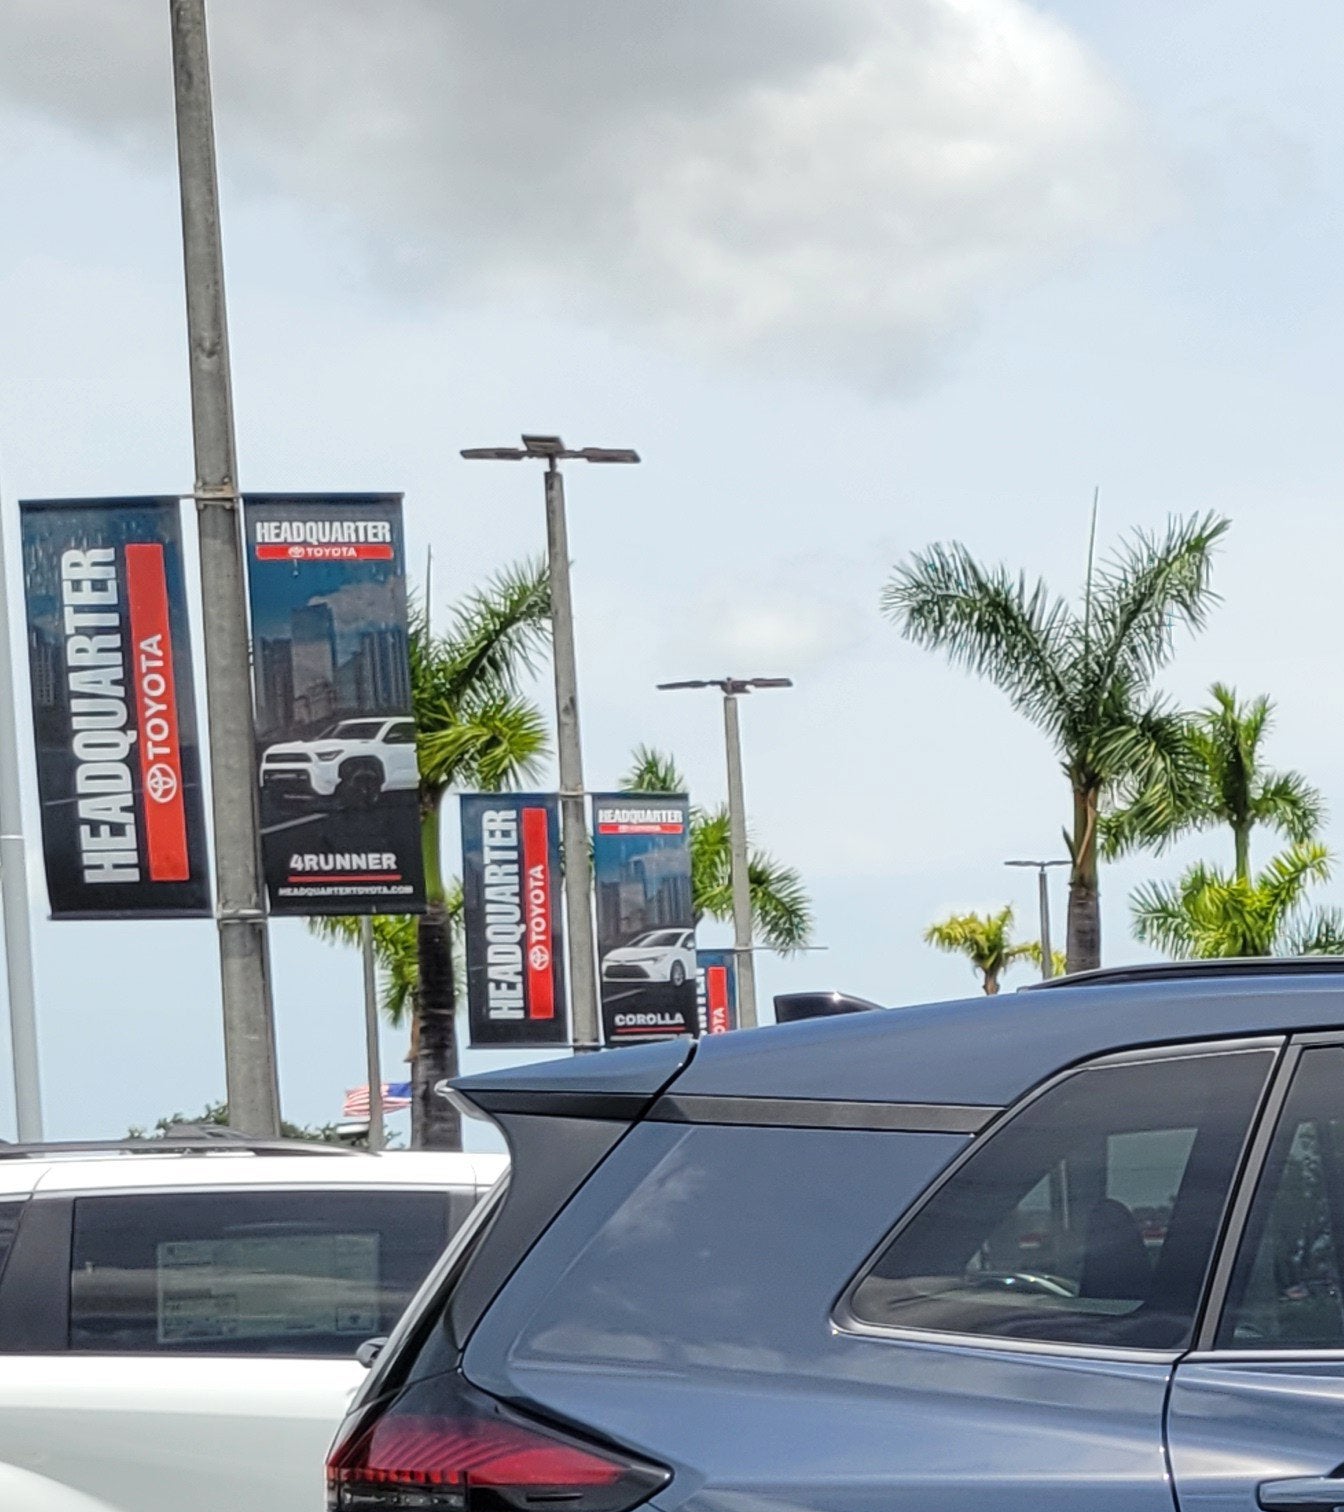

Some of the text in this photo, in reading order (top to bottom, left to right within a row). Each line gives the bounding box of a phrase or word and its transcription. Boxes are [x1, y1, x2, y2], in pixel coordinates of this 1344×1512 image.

[256, 521, 391, 545] HEADQUARTER
[307, 547, 357, 557] TOYOTA
[140, 633, 171, 761] TOYOTA
[61, 546, 140, 884] HEADQUARTER
[598, 809, 683, 825] HEADQUARTER
[290, 852, 398, 871] 4RUNNER
[481, 809, 526, 1020] HEADQUARTER
[529, 865, 547, 943] TOYOTA
[614, 1012, 685, 1026] COROLLA
